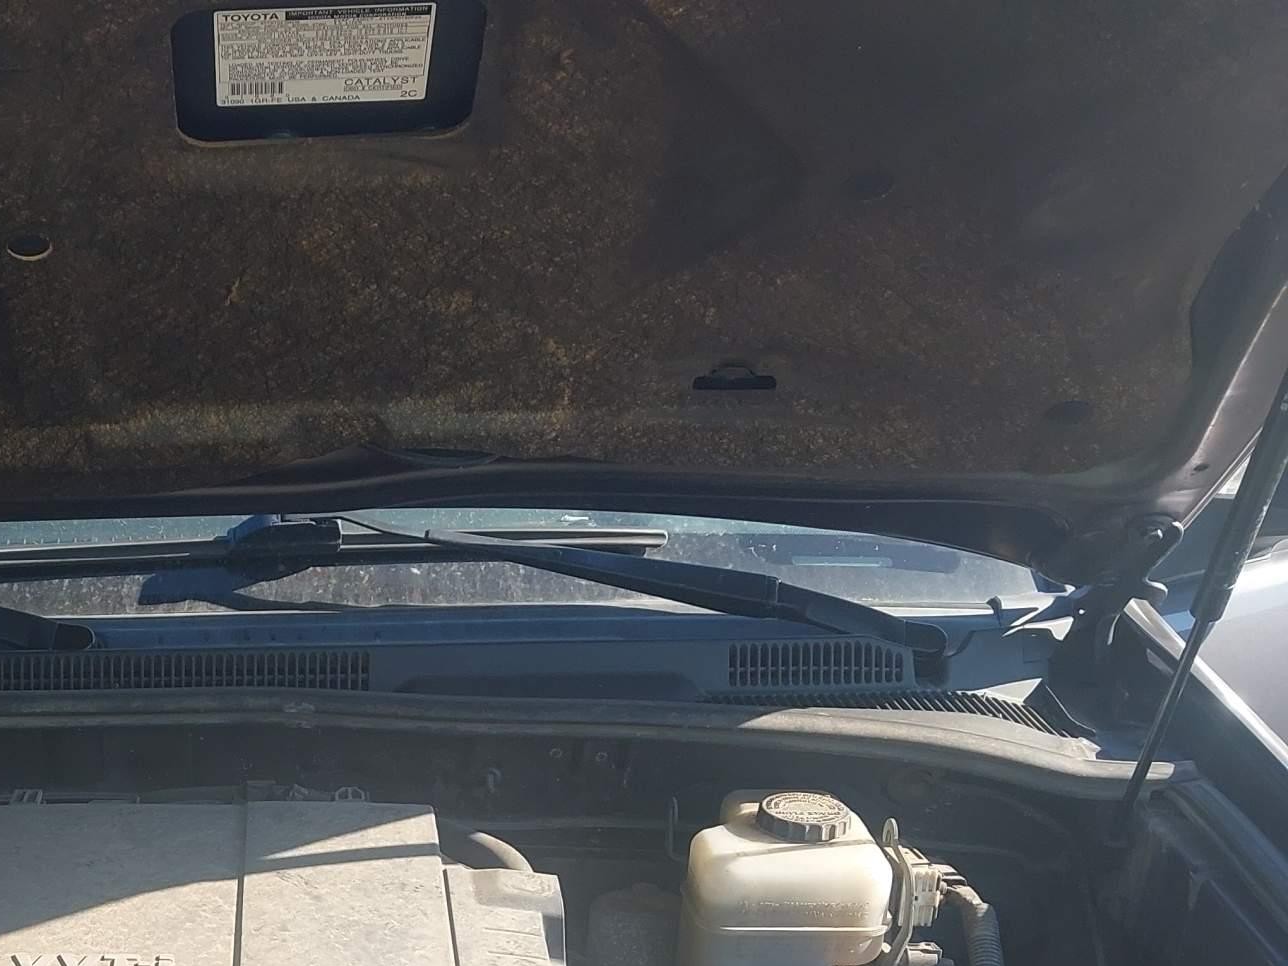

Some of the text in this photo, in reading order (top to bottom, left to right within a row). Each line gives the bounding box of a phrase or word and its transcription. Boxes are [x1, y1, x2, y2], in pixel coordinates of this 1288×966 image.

[222, 12, 279, 22] TOYOTA
[344, 76, 417, 86] CATALYST
[400, 89, 417, 97] 2C
[322, 94, 361, 102] CANADA
